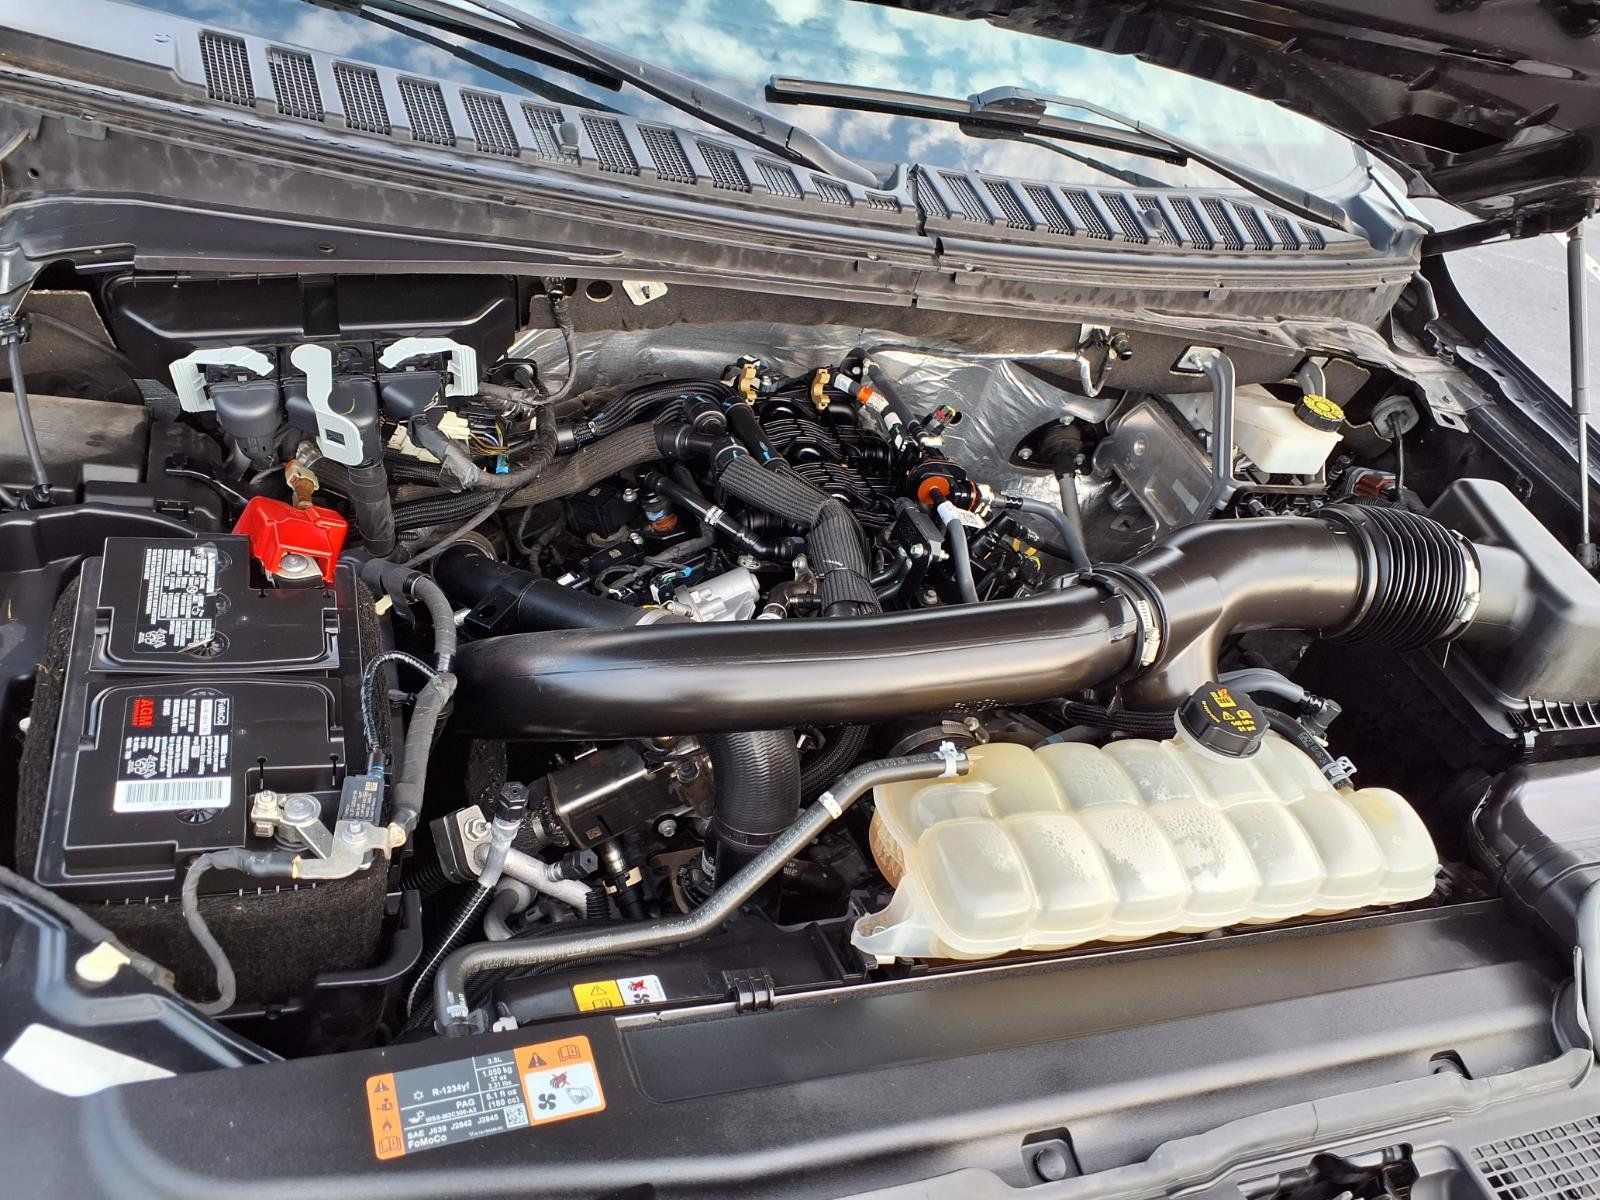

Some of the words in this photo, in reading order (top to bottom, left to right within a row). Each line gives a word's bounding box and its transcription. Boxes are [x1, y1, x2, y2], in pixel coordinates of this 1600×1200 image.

[140, 698, 154, 727] AGM
[503, 1066, 513, 1074] kg
[432, 1082, 470, 1097] R-1234yf
[507, 1088, 518, 1096] oz
[456, 1098, 475, 1109] PAG
[507, 1096, 520, 1105] cc)
[407, 1129, 425, 1140] SAE
[408, 1134, 447, 1149] FoMoCo
